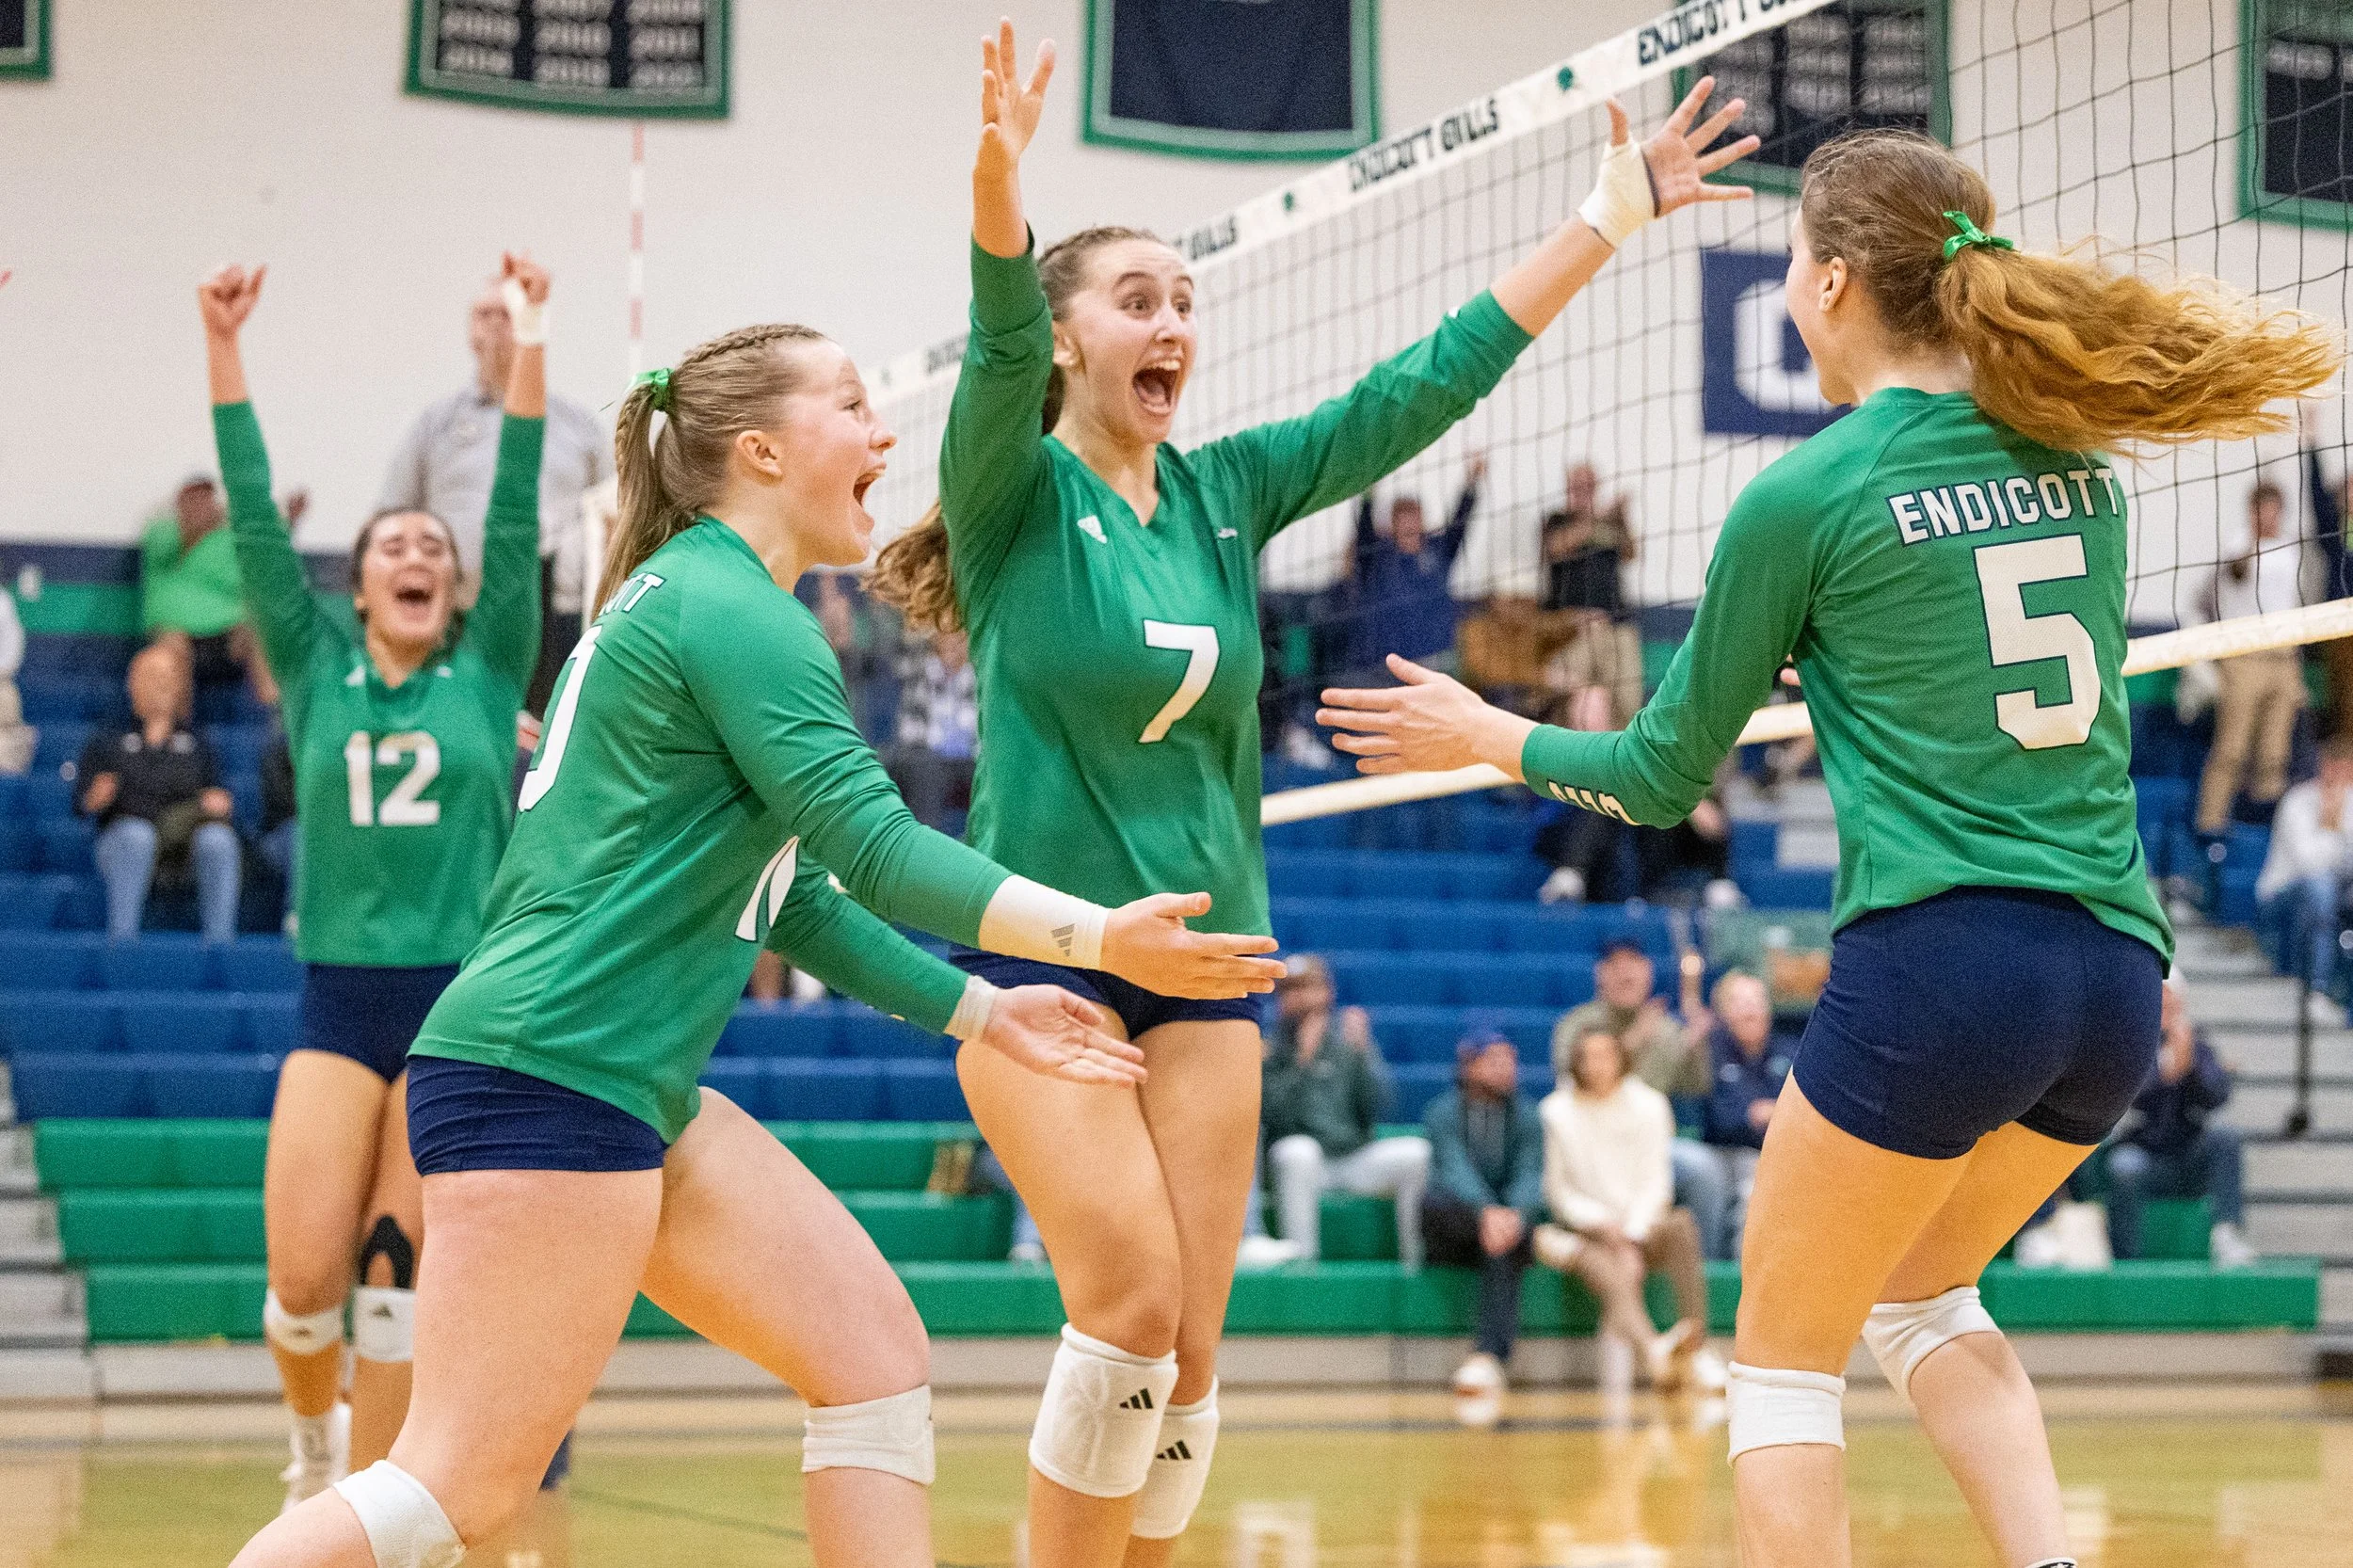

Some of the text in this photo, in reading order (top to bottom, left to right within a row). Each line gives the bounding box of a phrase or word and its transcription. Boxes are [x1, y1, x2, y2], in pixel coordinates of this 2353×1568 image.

[1886, 468, 2120, 545] ENDICOTT
[1138, 617, 1221, 744] 7
[1973, 533, 2103, 750] 5
[344, 729, 442, 826] 12
